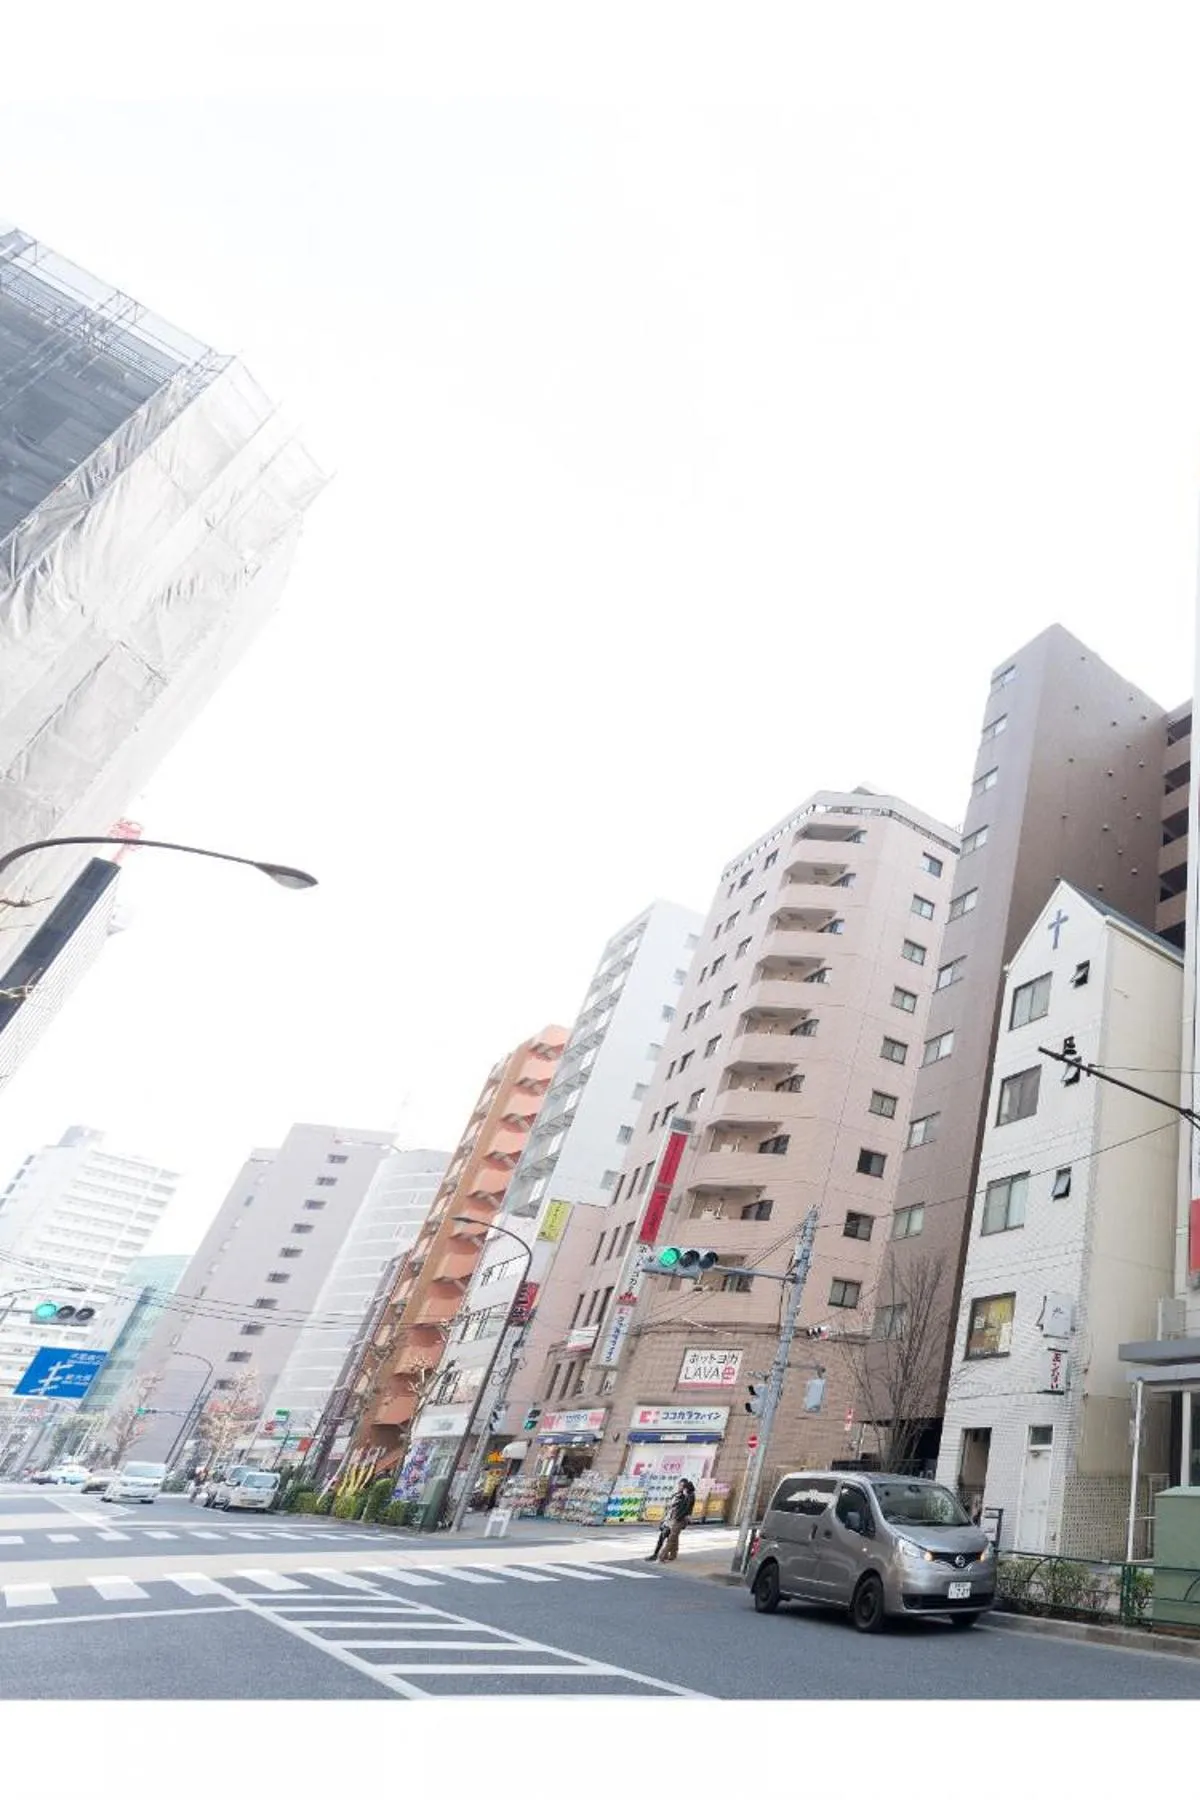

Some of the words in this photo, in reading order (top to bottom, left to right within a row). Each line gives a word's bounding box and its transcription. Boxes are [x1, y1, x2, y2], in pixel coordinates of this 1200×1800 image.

[685, 1366, 719, 1380] LAVA
[661, 1410, 721, 1421] ココカラファイン
